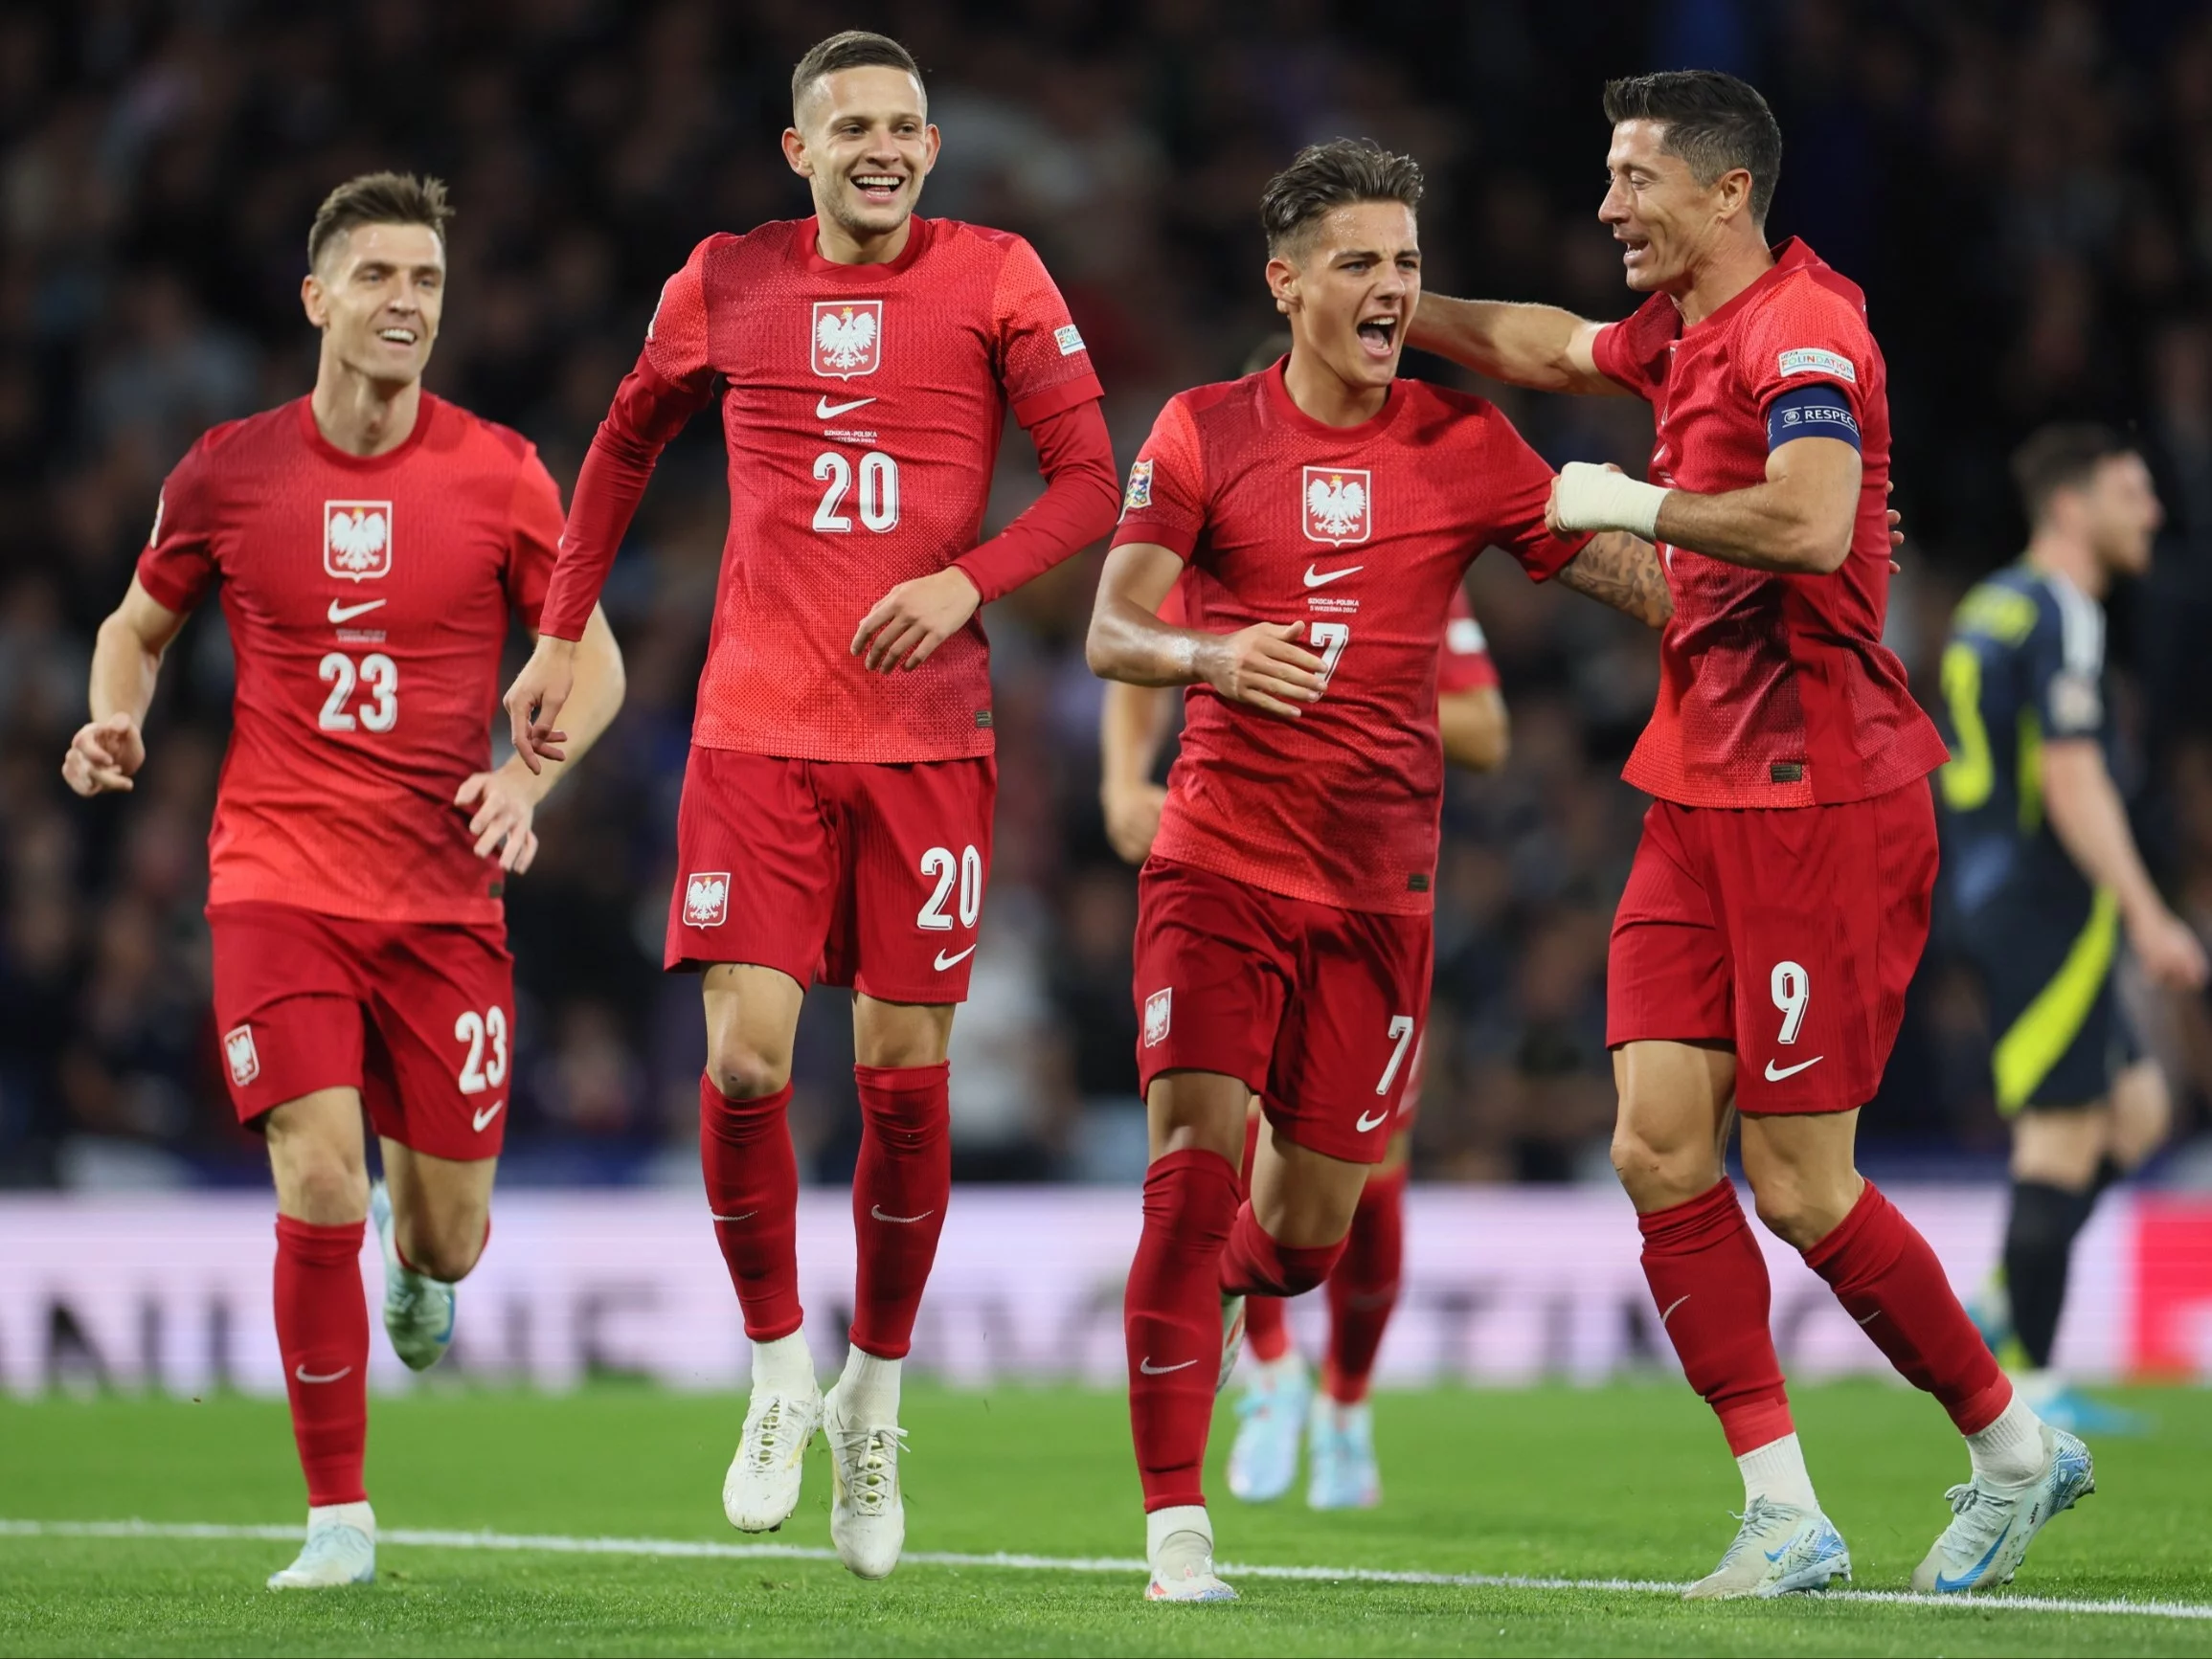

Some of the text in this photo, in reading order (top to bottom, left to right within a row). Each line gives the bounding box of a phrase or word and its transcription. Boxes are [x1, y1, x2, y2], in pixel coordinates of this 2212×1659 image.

[1782, 355, 1853, 375] FOUNDATION
[813, 452, 899, 533] 20
[319, 652, 397, 732] 23
[1310, 622, 1349, 698] 7
[916, 844, 982, 930] 20
[1772, 960, 1809, 1044] 9
[454, 1005, 507, 1094] 23
[1375, 1015, 1413, 1095] 7
